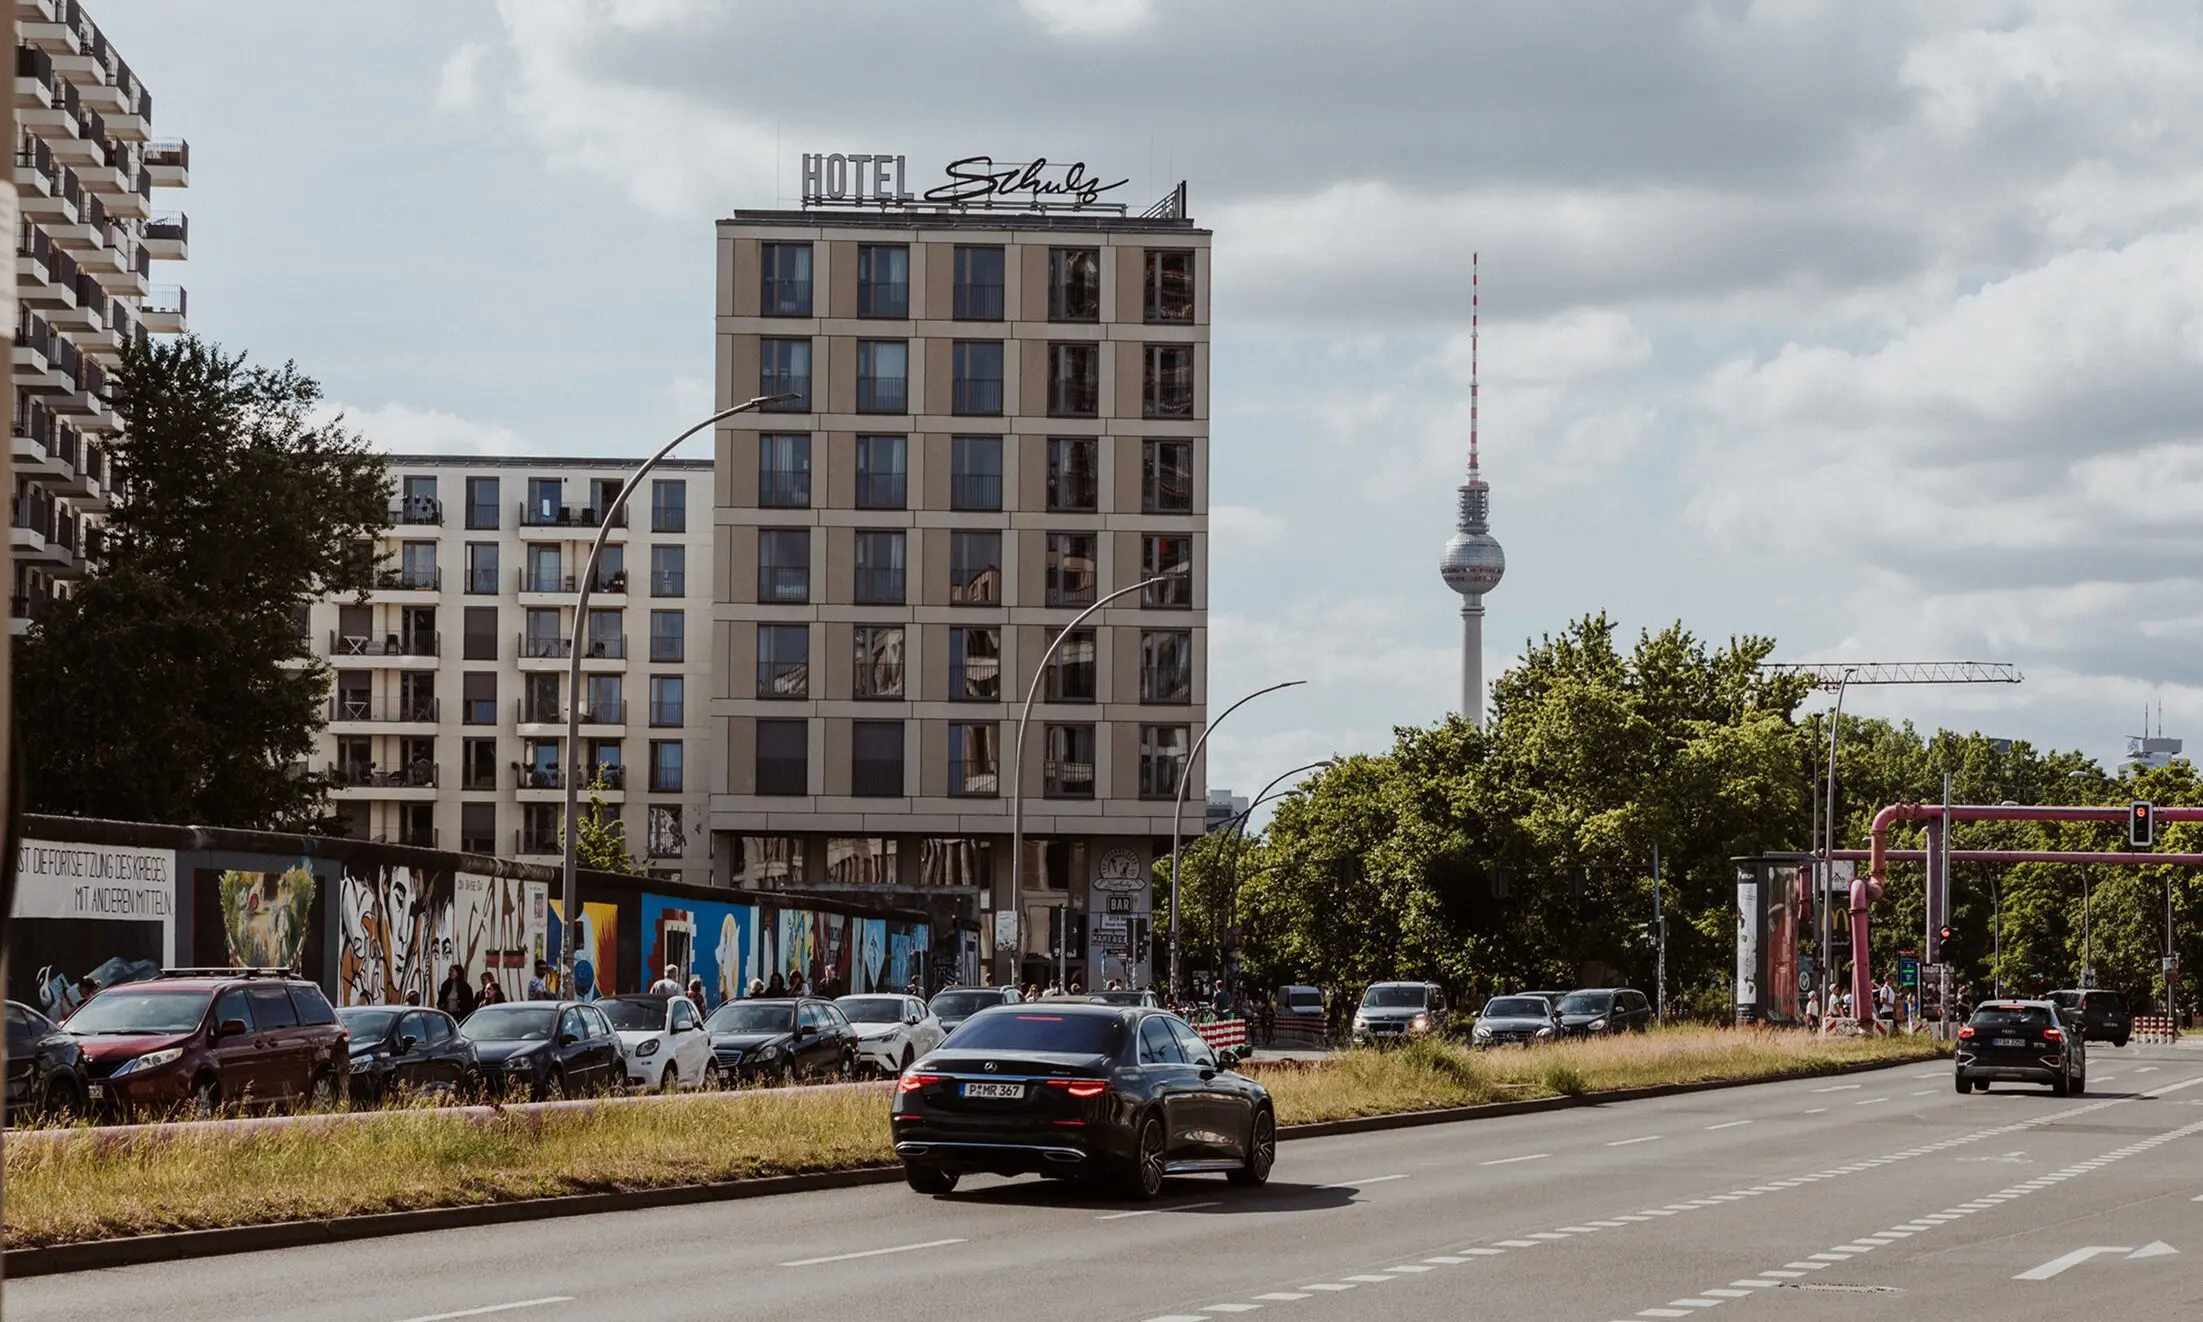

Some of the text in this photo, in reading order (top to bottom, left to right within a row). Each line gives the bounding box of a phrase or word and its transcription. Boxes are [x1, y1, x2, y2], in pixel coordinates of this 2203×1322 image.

[802, 153, 1130, 204] HOTEL Schulz
[16, 846, 167, 883] ST DIE FORTSETZUNG DES KRIEGES
[74, 886, 90, 912] MIT
[91, 887, 135, 914] ANDEREN
[1110, 898, 1130, 911] BAR
[969, 1085, 1020, 1097] P MR 367
